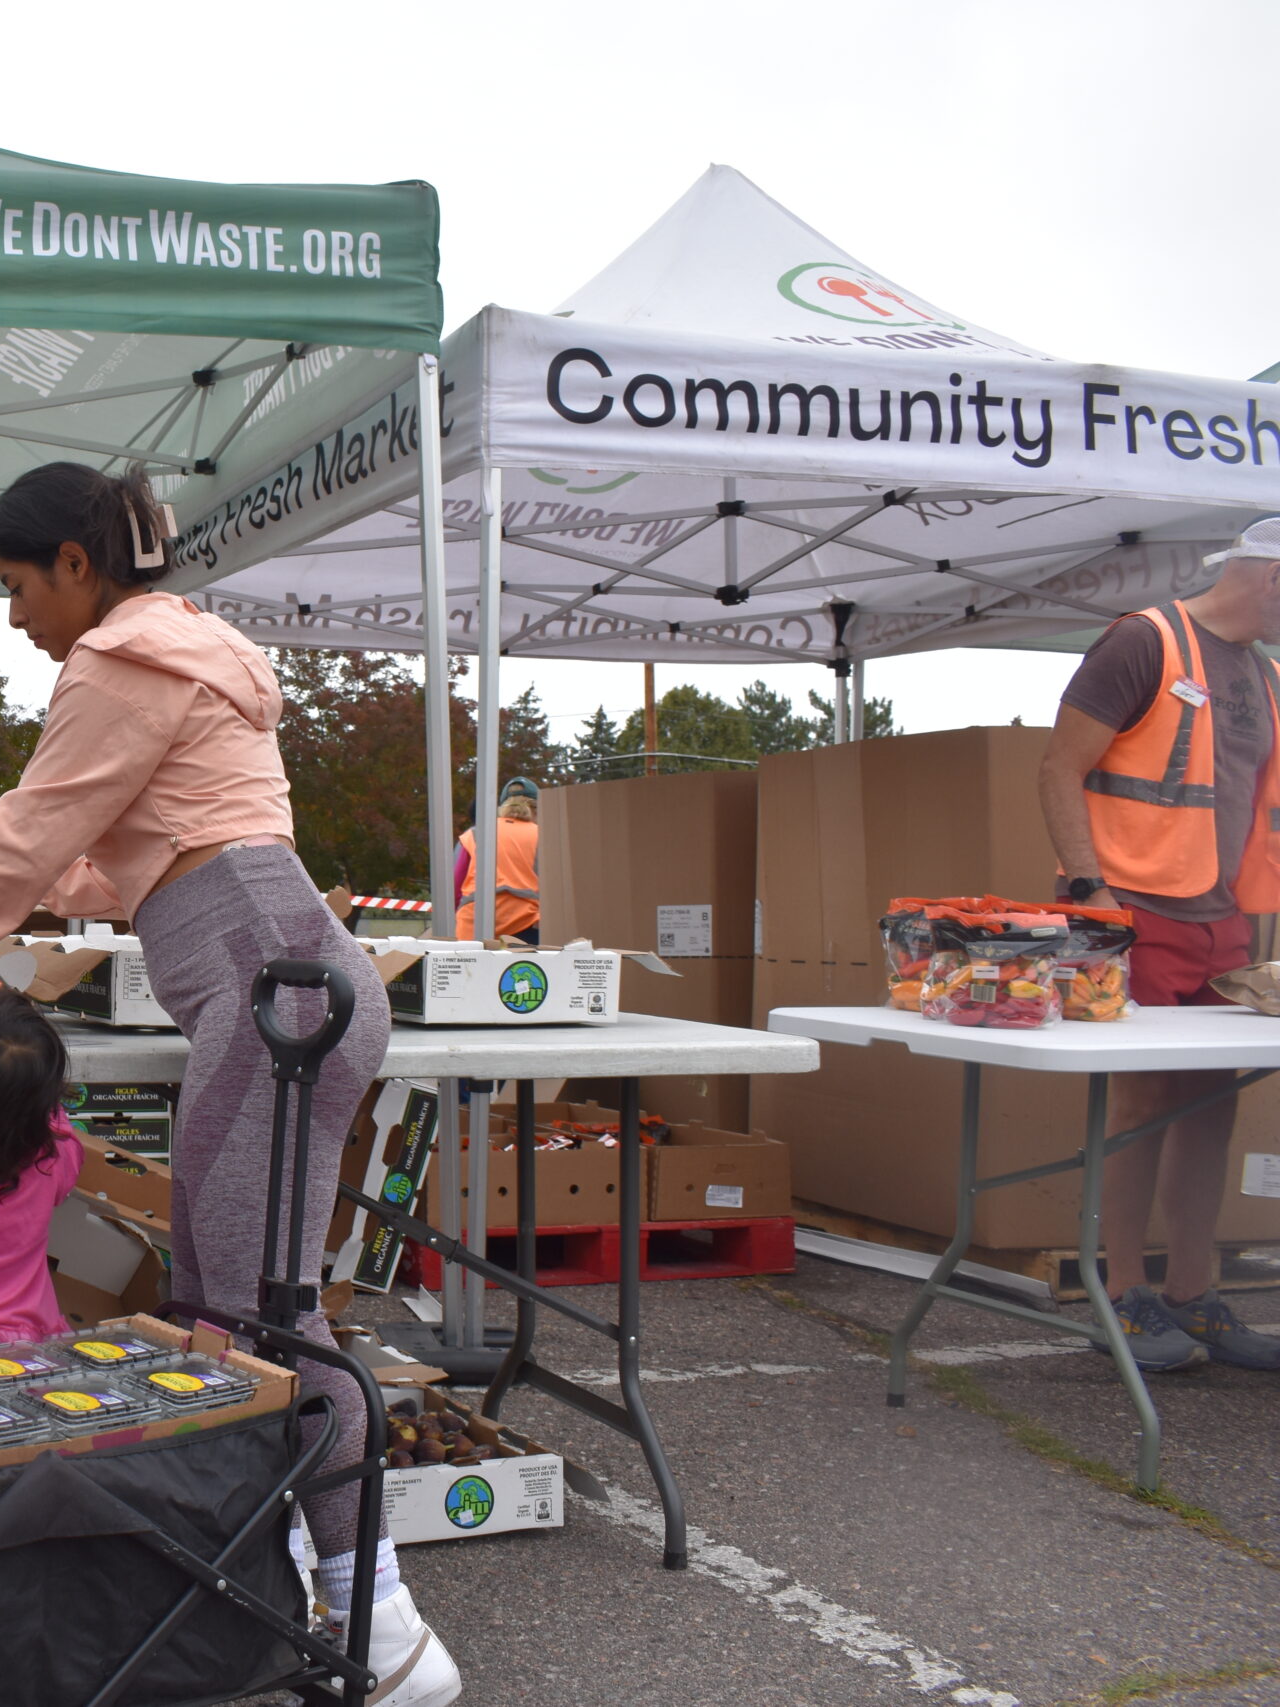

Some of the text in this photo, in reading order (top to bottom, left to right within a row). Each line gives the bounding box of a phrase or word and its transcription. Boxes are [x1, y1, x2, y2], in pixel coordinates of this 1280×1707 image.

[546, 347, 1280, 469] Community Fresh
[220, 461, 304, 546] Fresh
[115, 1087, 139, 1095] FIGUES
[133, 1092, 159, 1100] FRAÎCHE
[116, 1128, 140, 1136] FIGUES
[373, 1227, 387, 1254] FRESH
[520, 1471, 542, 1479] PRODUIT
